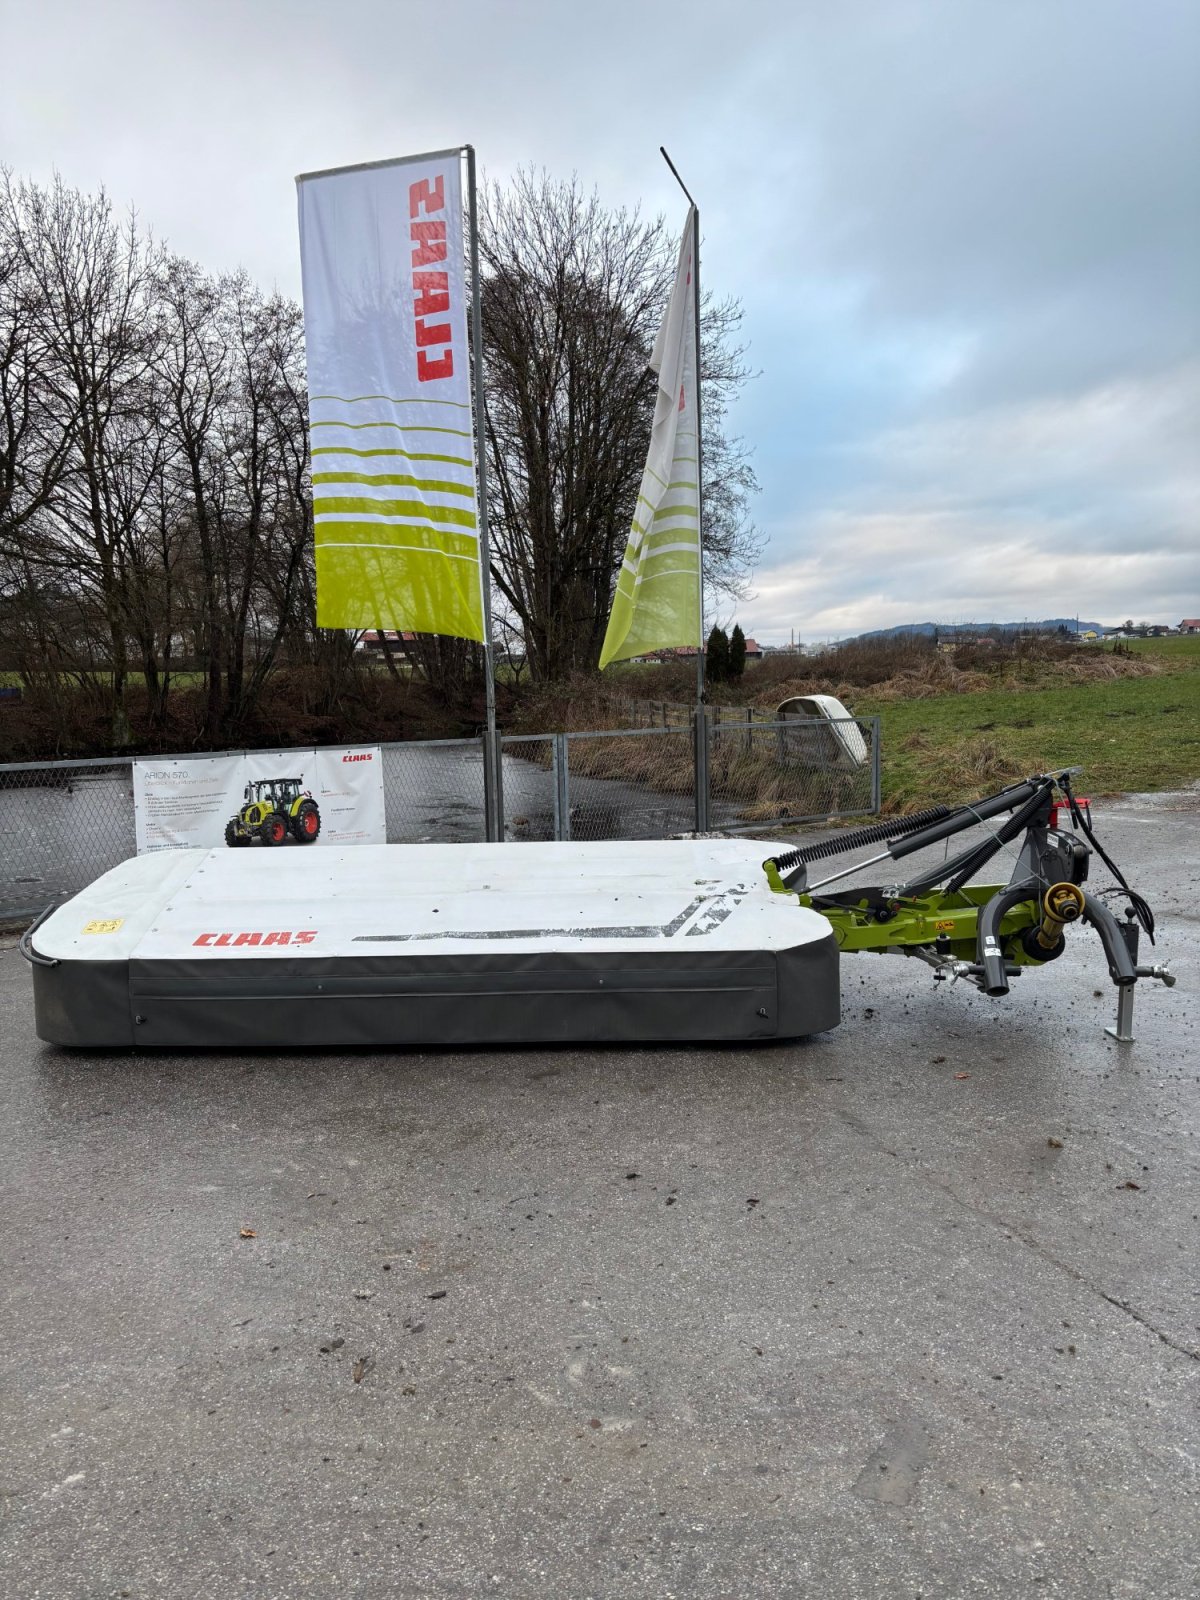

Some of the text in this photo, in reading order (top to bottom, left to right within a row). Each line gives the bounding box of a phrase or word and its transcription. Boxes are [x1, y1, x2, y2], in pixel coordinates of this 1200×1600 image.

[342, 753, 373, 763] CLAAS
[144, 771, 189, 780] ARION 570
[192, 930, 319, 947] CLAAS
